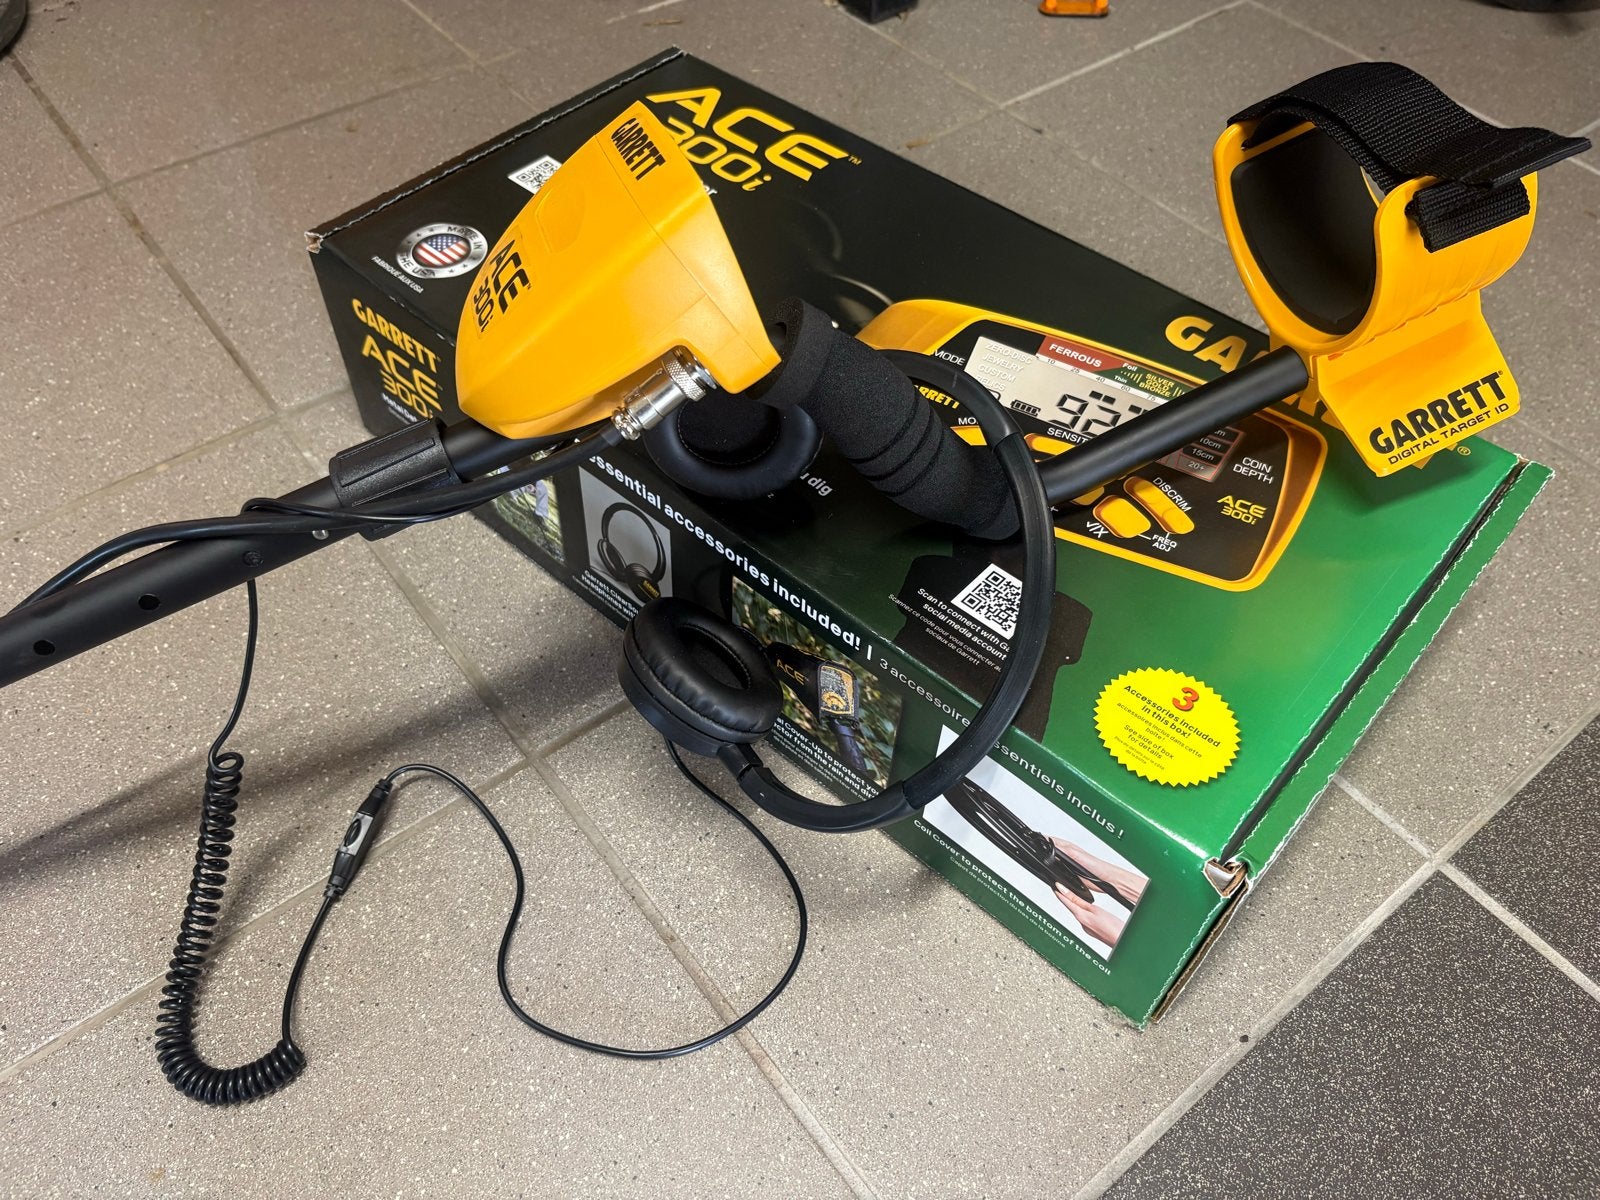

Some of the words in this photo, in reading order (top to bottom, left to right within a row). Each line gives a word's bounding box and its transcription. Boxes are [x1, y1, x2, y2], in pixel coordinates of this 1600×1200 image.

[645, 87, 849, 182] ACE
[610, 117, 666, 181] GARRETT
[447, 226, 479, 241] MADE
[473, 240, 484, 250] IN
[400, 252, 414, 269] THE
[412, 265, 436, 278] USA
[489, 240, 530, 315] ACE
[410, 281, 424, 294] USA
[473, 276, 494, 333] 300i
[352, 298, 438, 374] GARRETT
[933, 350, 966, 366] MODE
[981, 353, 1024, 373] JEWELRY
[985, 343, 1034, 365] ZERO-DISC
[1049, 343, 1103, 368] FERROUS
[1122, 362, 1138, 372] Foil
[362, 334, 442, 412] ACE
[977, 363, 1017, 384] CUSTOM
[1114, 375, 1128, 384] Thin
[1145, 373, 1175, 388] SILVER
[1145, 379, 1169, 391] GOLD
[380, 369, 433, 420] 300i
[914, 385, 960, 409] RRETT
[1139, 382, 1172, 398] BRONZE
[957, 417, 978, 426] MO
[1369, 371, 1506, 455] GARRETT
[1047, 427, 1089, 446] SENSIT
[1388, 439, 1440, 465] DIGITAL
[1440, 410, 1491, 440] TARGET
[1494, 403, 1510, 415] ID
[1191, 447, 1215, 461] 15cm
[1242, 457, 1272, 473] COIN
[807, 477, 833, 496] dig
[1233, 463, 1274, 484] DEPTH
[1152, 477, 1192, 512] DISCRIM
[1216, 495, 1267, 519] ACE
[1221, 505, 1257, 525] 300i
[1152, 534, 1177, 549] FREQ
[1152, 543, 1172, 552] ADJ
[663, 504, 771, 586] accessories
[773, 578, 861, 651] included!
[581, 574, 622, 609] Headphones
[917, 588, 938, 604] Scan
[937, 601, 948, 610] to
[946, 608, 981, 633] connect
[980, 630, 1000, 645] with
[888, 593, 914, 613] Scannez
[911, 609, 921, 618] ce
[919, 614, 936, 628] code
[933, 624, 950, 637] pour
[948, 634, 964, 647] vous
[962, 643, 995, 667] connecter
[922, 603, 948, 622] social
[946, 619, 972, 639] media
[971, 635, 1007, 660] account
[925, 627, 949, 645] sociaux
[947, 641, 957, 651] de
[955, 647, 980, 666] Garrett
[777, 659, 806, 686] ACE
[1172, 687, 1199, 711] 3
[1123, 685, 1180, 723] Accessories
[1179, 718, 1221, 748] included
[1141, 704, 1151, 714] in
[1151, 711, 1169, 726] this
[1169, 722, 1192, 739] box!
[1117, 702, 1152, 727] accessoires
[1151, 723, 1171, 738] inclus
[1169, 734, 1185, 748] dans
[1184, 744, 1203, 758] cette
[1123, 724, 1138, 736] See
[1137, 733, 1153, 745] side
[1152, 743, 1162, 751] of
[1160, 748, 1175, 760] box
[785, 722, 823, 754] Cover-Up
[823, 751, 834, 762] to
[833, 760, 866, 786] protect
[879, 658, 889, 670] 3
[889, 667, 970, 727] accessoire
[993, 741, 1065, 795] ssentiels
[1067, 791, 1115, 833] inclus
[1117, 829, 1125, 839] !
[1127, 733, 1139, 743] for
[1138, 742, 1163, 759] details
[794, 736, 813, 755] from
[814, 752, 828, 766] the
[828, 763, 844, 778] rain
[844, 776, 860, 790] and
[913, 819, 932, 836] Coil
[932, 833, 960, 859] Cover
[960, 854, 971, 866] to
[971, 863, 1008, 894] protect
[1008, 891, 1025, 908] the
[1025, 903, 1063, 937] bottom
[1063, 935, 1075, 946] of
[1074, 942, 1092, 960] the
[1092, 958, 1111, 976] coil
